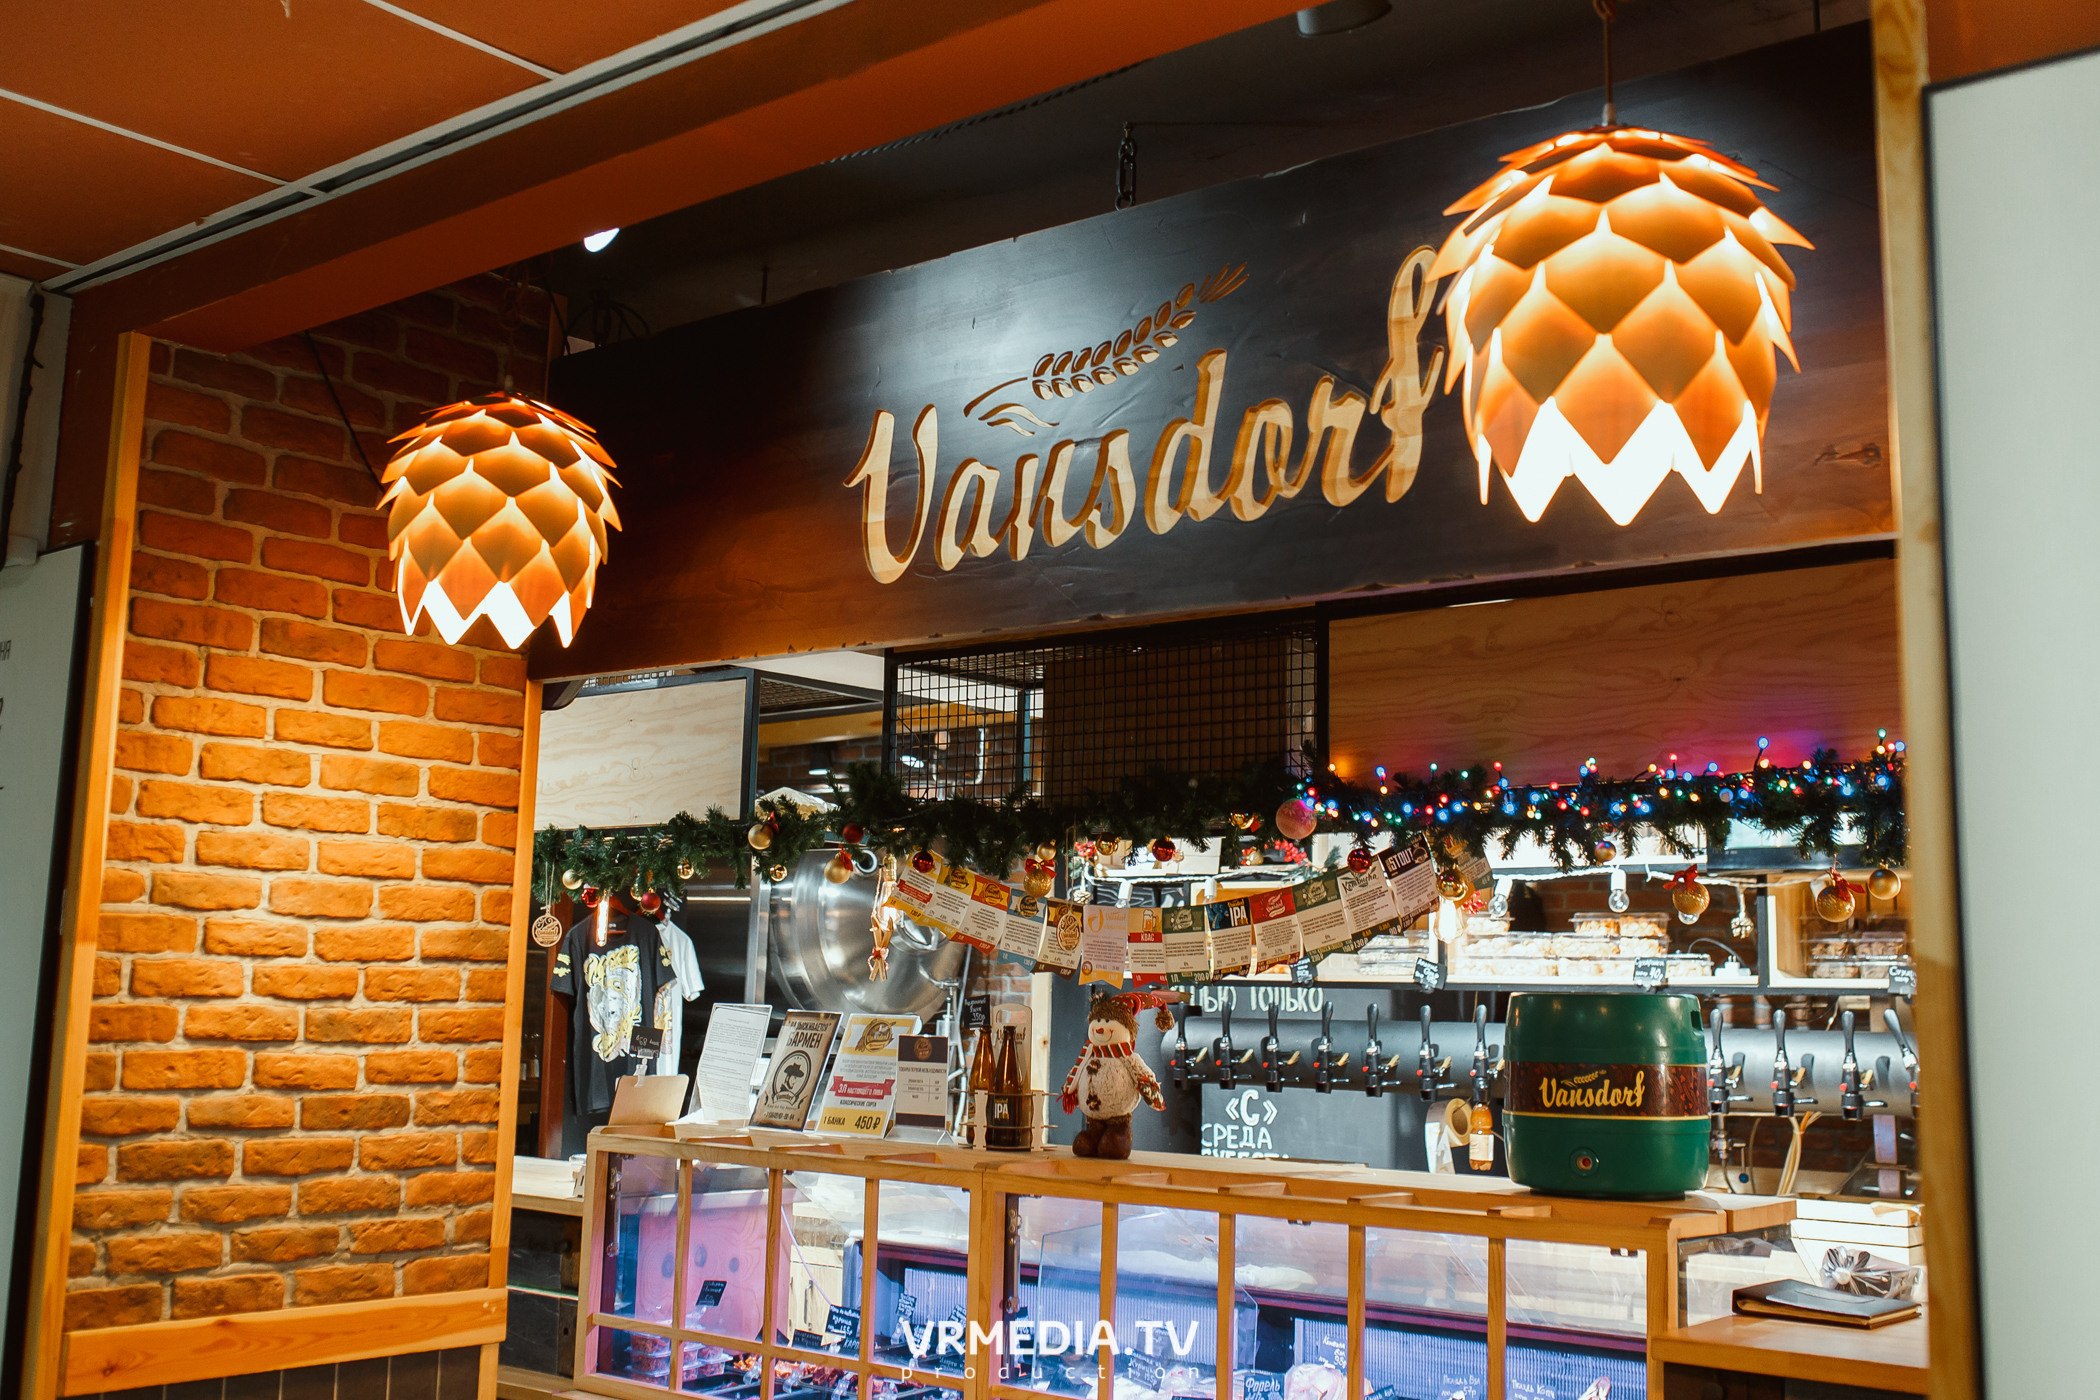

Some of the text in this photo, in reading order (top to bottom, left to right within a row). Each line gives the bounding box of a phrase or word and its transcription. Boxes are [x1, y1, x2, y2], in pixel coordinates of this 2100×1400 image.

[844, 245, 1444, 584] Vansdorf
[1389, 848, 1413, 870] STOUT
[1230, 905, 1247, 927] IPA
[1140, 933, 1155, 942] КВАС
[1538, 1070, 1646, 1108] Vansdorf
[827, 1117, 846, 1126] БАНКА
[994, 1103, 1009, 1120] IPA
[1201, 1123, 1273, 1150] СРЕДА
